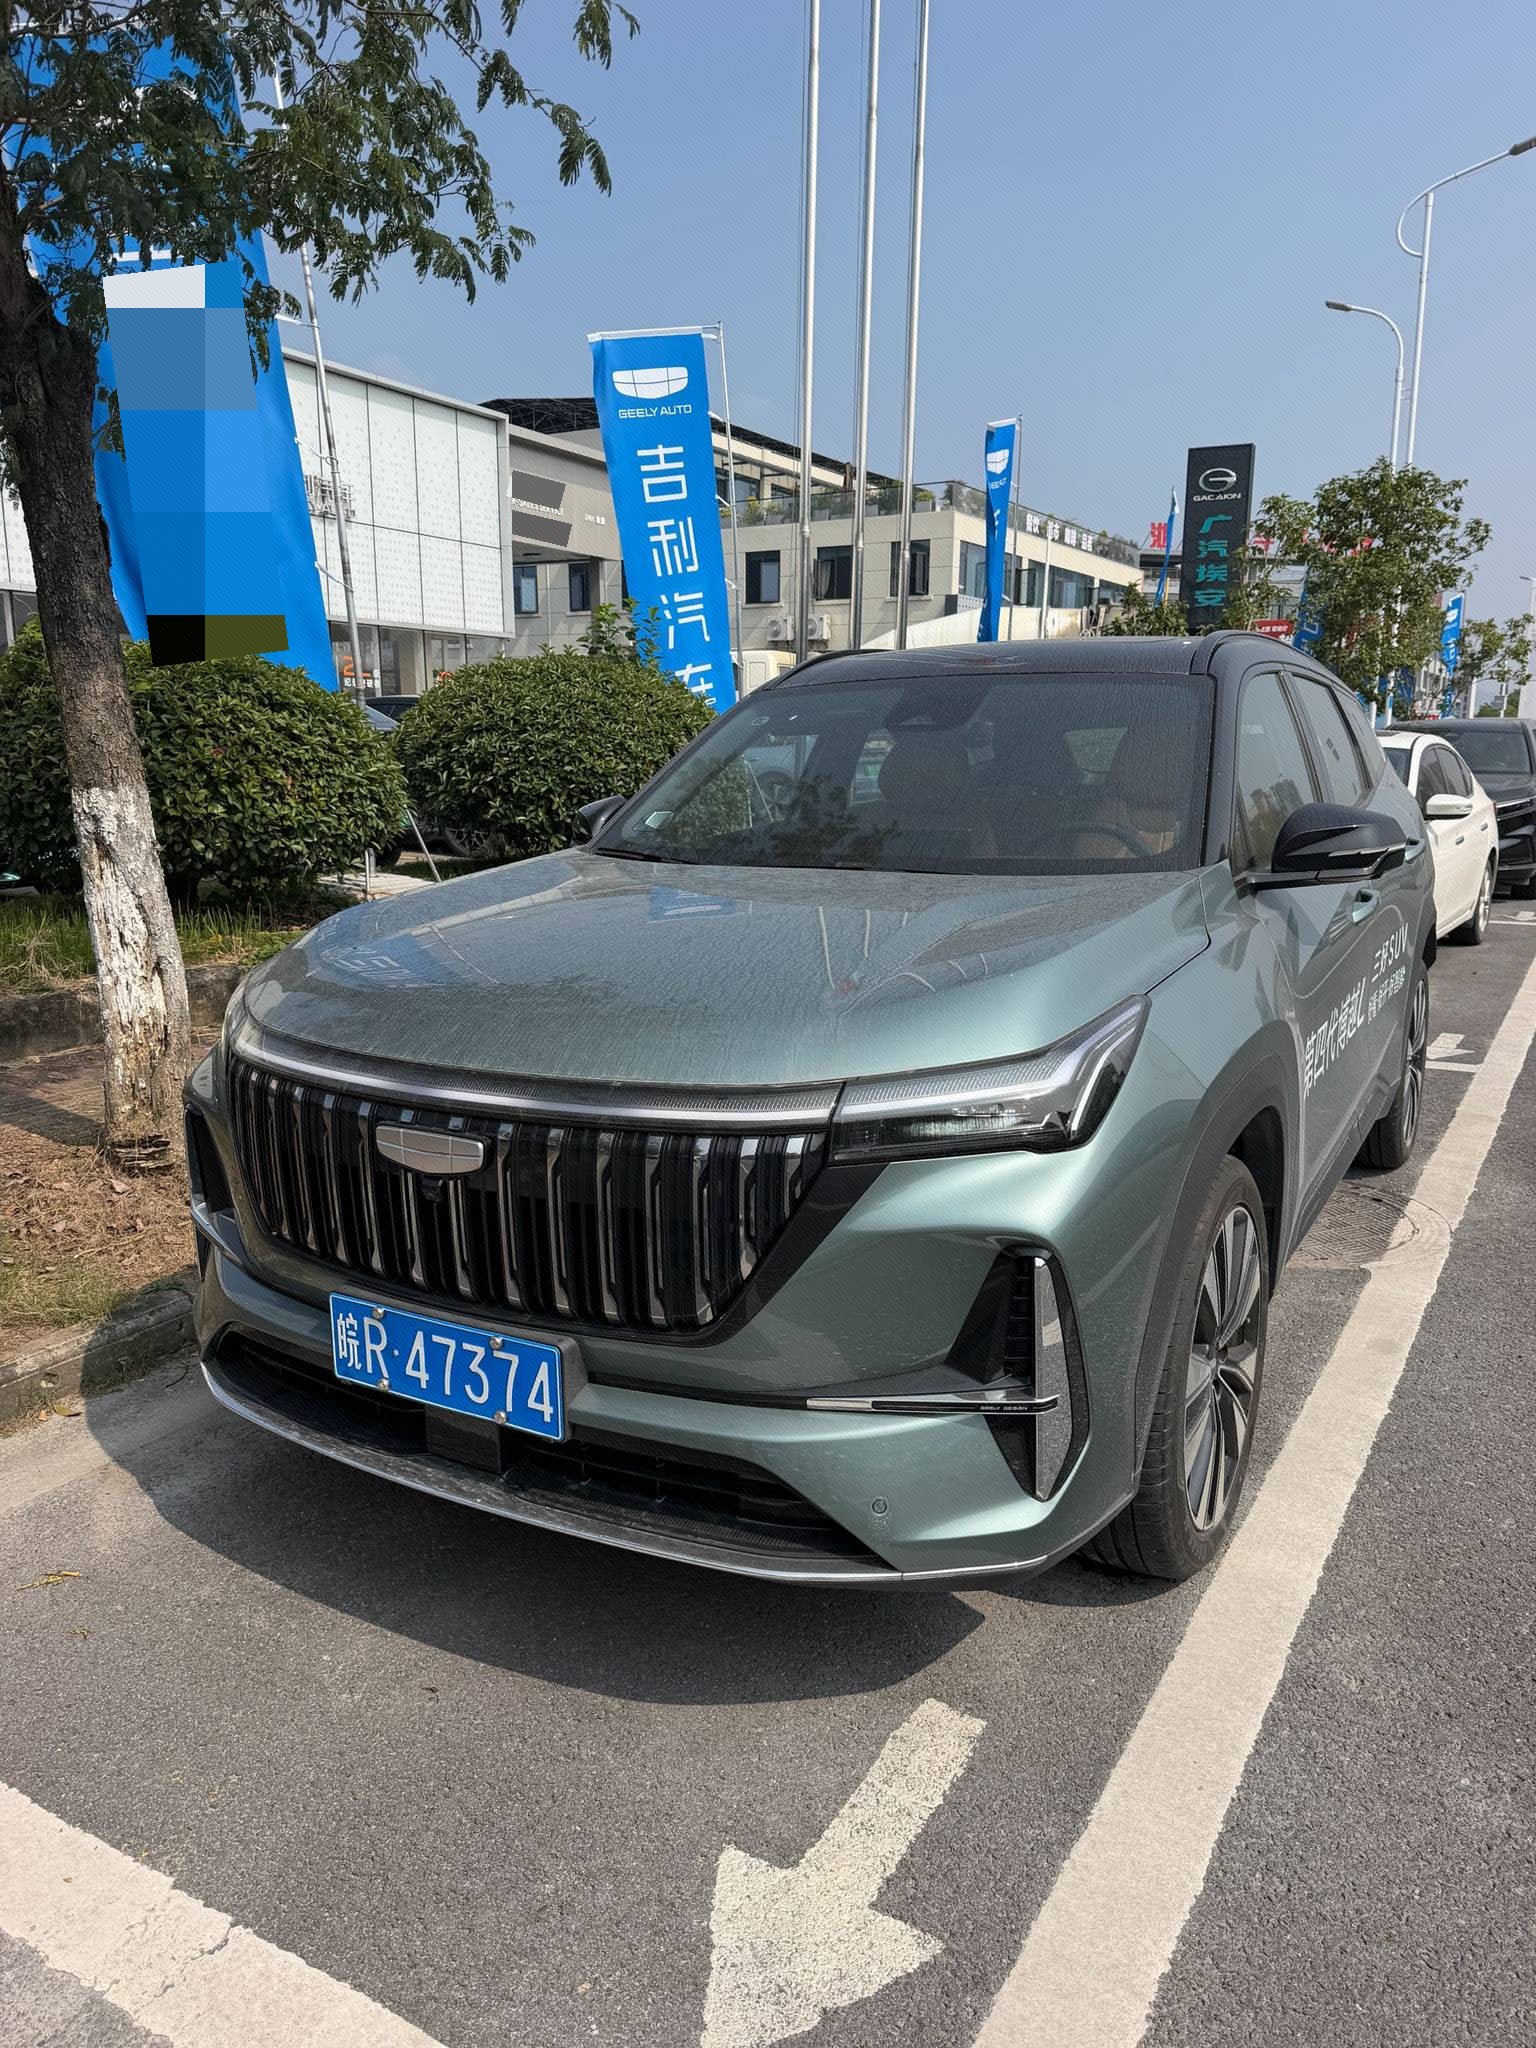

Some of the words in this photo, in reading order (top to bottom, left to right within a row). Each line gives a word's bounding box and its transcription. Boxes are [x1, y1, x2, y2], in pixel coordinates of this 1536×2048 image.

[618, 407, 658, 419] GEELY
[660, 404, 692, 416] AUTO
[1195, 514, 1233, 607] 广汽埃安
[337, 1312, 554, 1423] 皖R·47374
